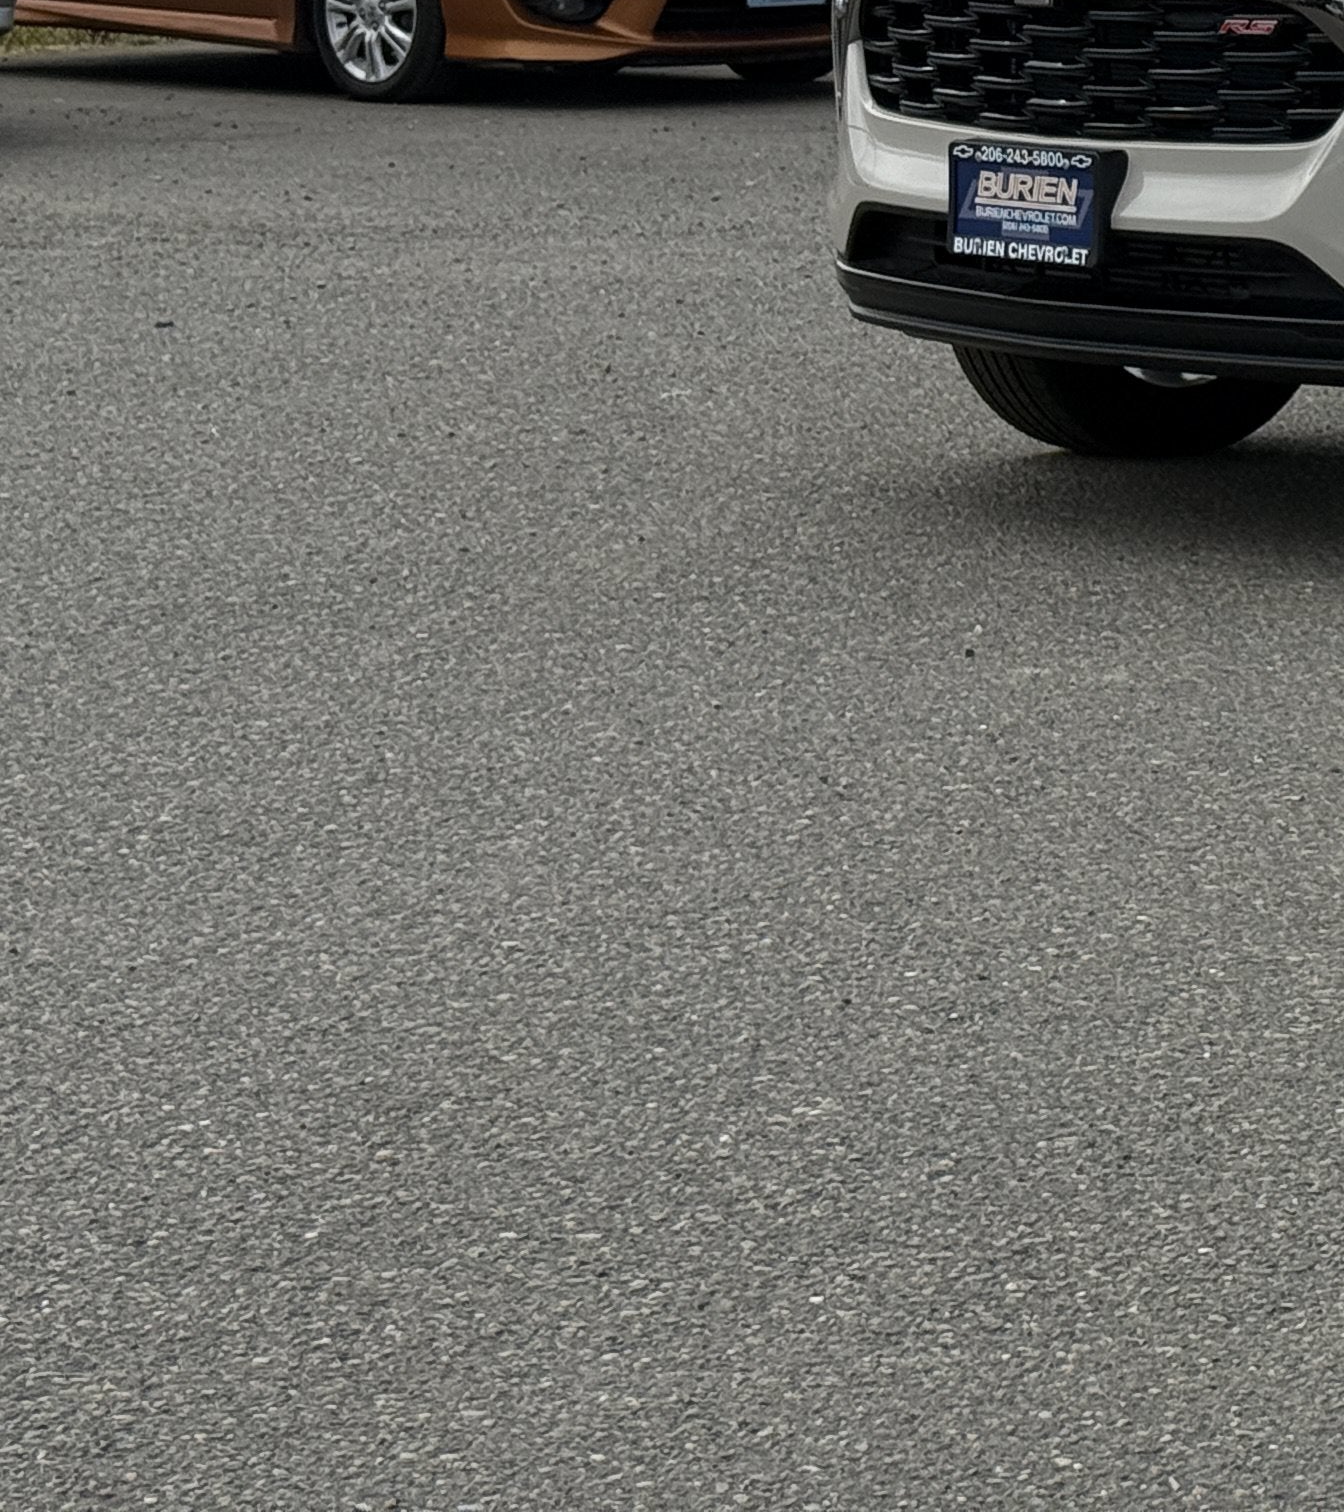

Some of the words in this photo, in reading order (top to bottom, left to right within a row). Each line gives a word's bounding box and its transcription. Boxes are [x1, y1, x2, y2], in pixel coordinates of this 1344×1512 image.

[1219, 19, 1278, 35] RS
[980, 146, 1064, 167] 206-243-5800
[976, 170, 1078, 205] BURIEN
